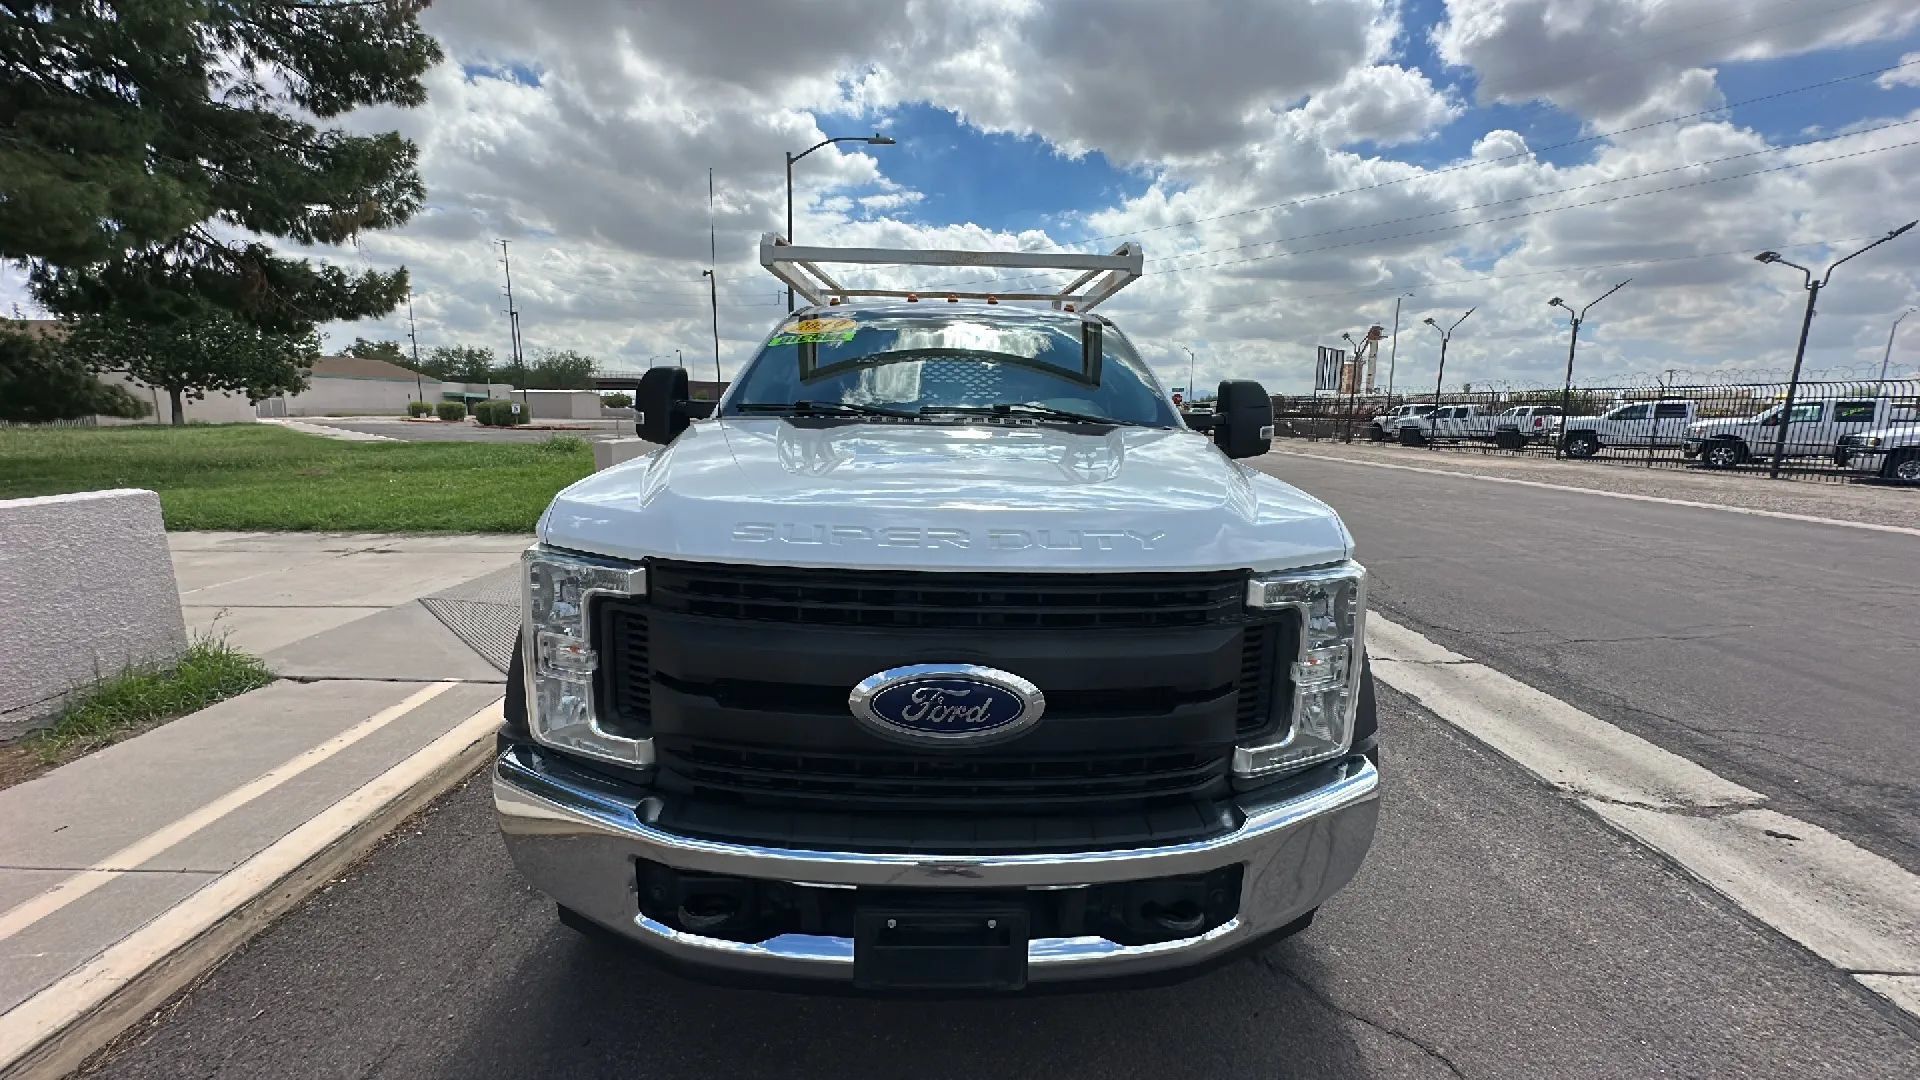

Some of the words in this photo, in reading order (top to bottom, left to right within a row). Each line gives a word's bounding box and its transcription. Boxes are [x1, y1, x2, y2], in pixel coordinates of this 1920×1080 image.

[731, 521, 970, 549] SUPER
[986, 529, 1165, 549] DUTY
[901, 687, 993, 723] Ford
